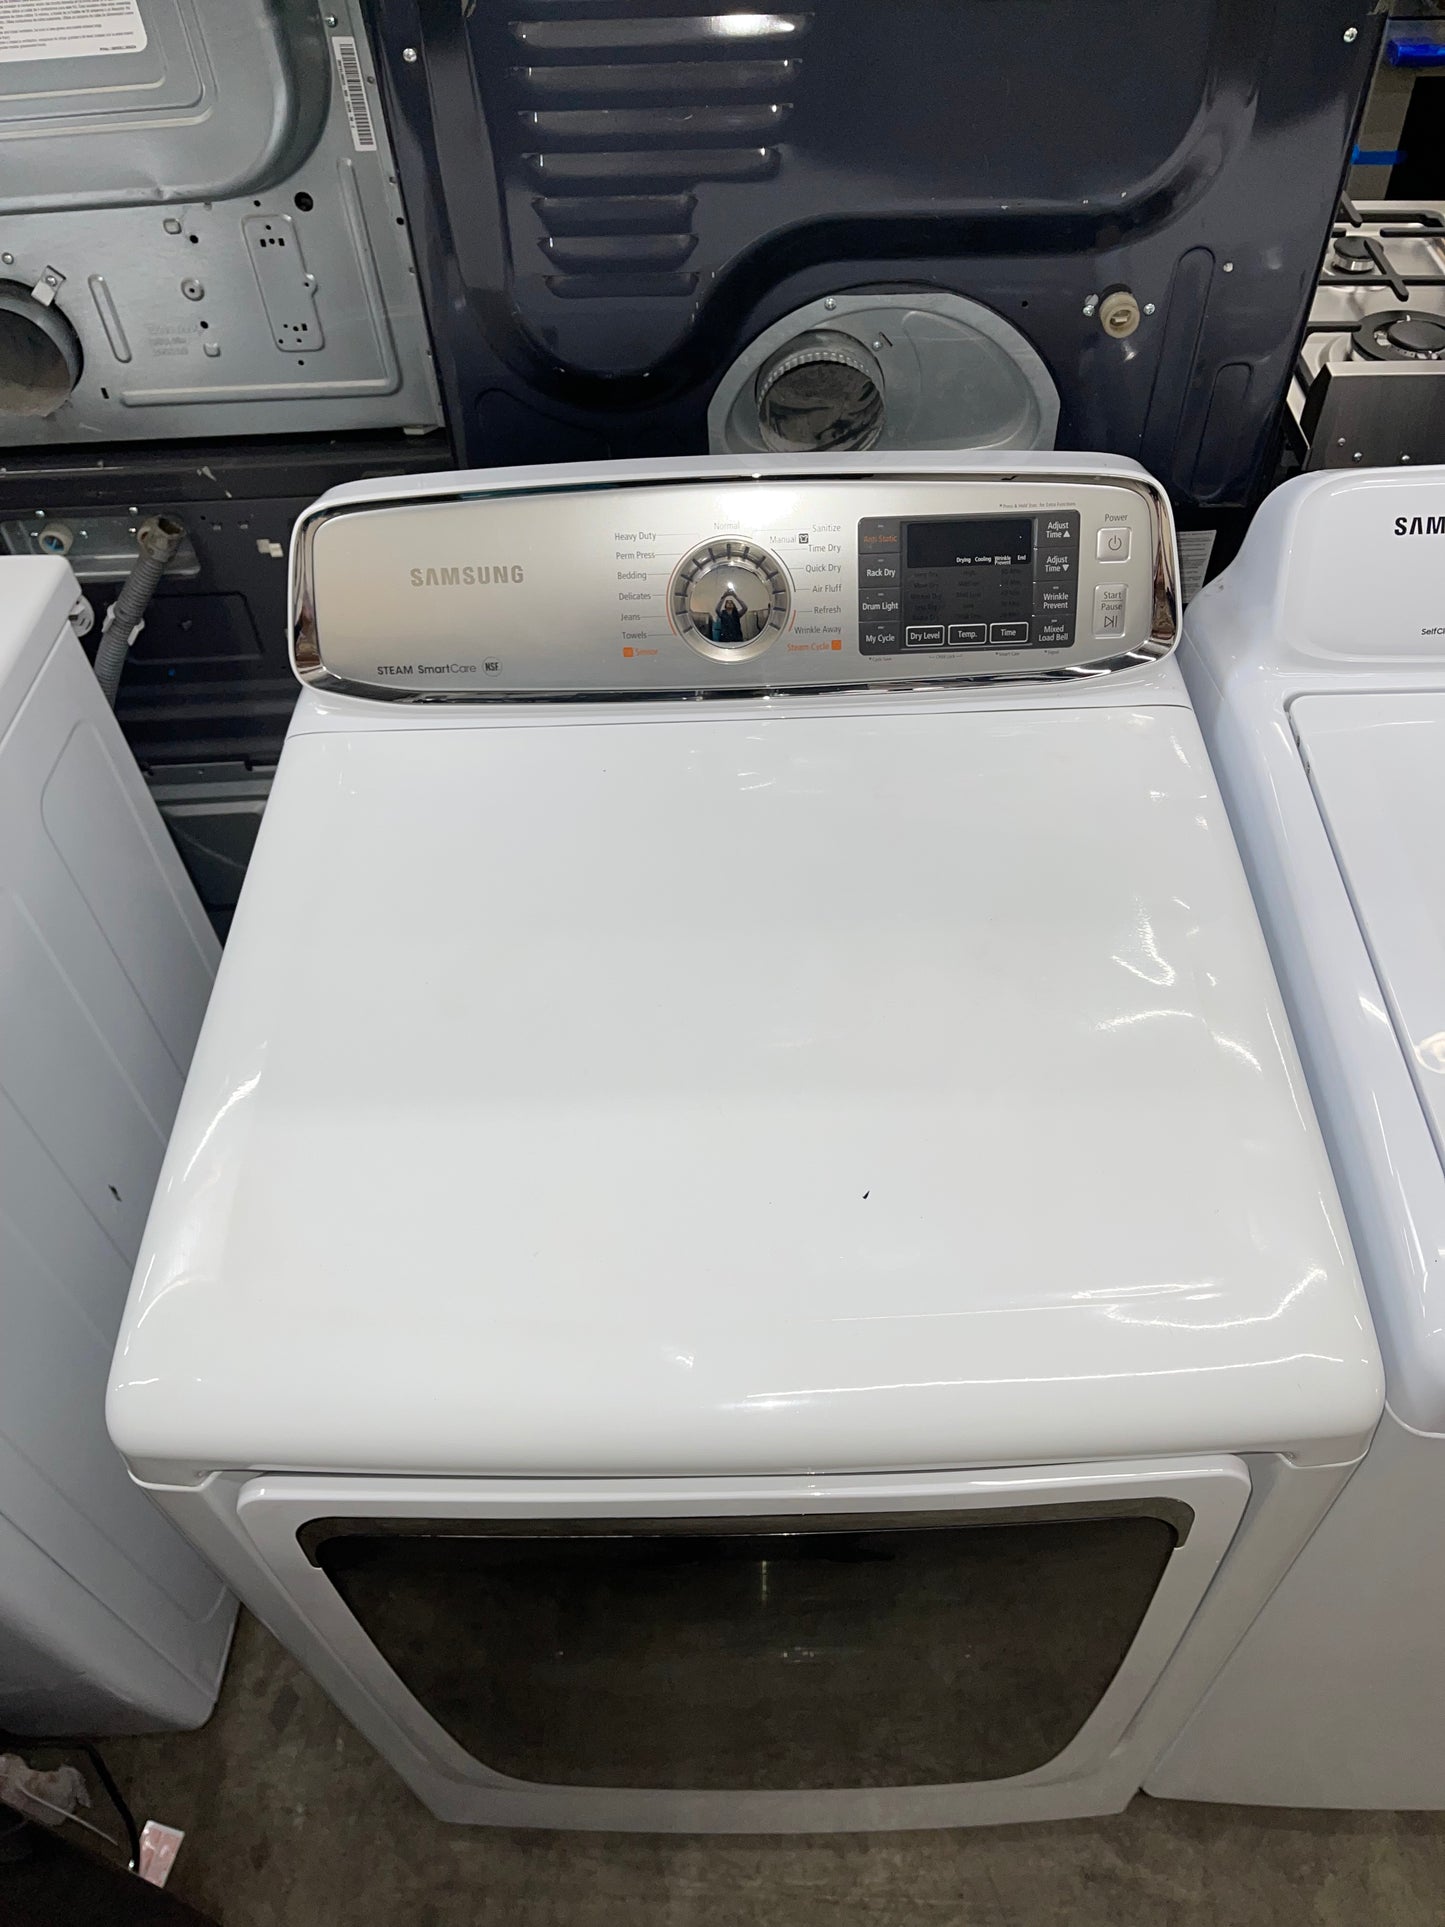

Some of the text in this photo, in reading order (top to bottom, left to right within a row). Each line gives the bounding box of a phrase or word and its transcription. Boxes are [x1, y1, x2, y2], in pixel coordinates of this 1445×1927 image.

[1104, 514, 1128, 522] Power
[714, 522, 740, 530] Normal
[812, 524, 841, 532] Sanitize
[1048, 521, 1069, 530] Adjust
[1394, 516, 1445, 536] SAM
[614, 532, 656, 541] Heavy Duty
[1046, 530, 1062, 538] Time
[770, 536, 796, 544] Manual
[808, 544, 842, 554] Time Dry
[636, 551, 656, 559] Press
[1046, 556, 1068, 564] Adjust
[806, 564, 842, 574] Quick Dry
[1045, 564, 1061, 572] Time
[410, 565, 524, 587] SAMSUNG
[617, 571, 647, 580] Bedding
[866, 568, 896, 578] Rack Dry
[824, 584, 842, 592] Fluff
[1043, 592, 1068, 600] Wrinkle
[1104, 591, 1121, 600] Start
[863, 602, 898, 611] Drum Light
[621, 614, 640, 622] Jeans
[795, 626, 841, 634] Wrinkle Away
[1001, 628, 1016, 636] Time
[622, 631, 647, 640] Towels
[866, 634, 895, 644] My Cycle
[910, 632, 940, 641] Dry Level
[958, 630, 977, 640] Temp.
[1056, 633, 1068, 641] Bell
[787, 642, 829, 652] Steam Cycle
[377, 664, 476, 675] STEAM SmartCare
[484, 662, 499, 672] NSF
